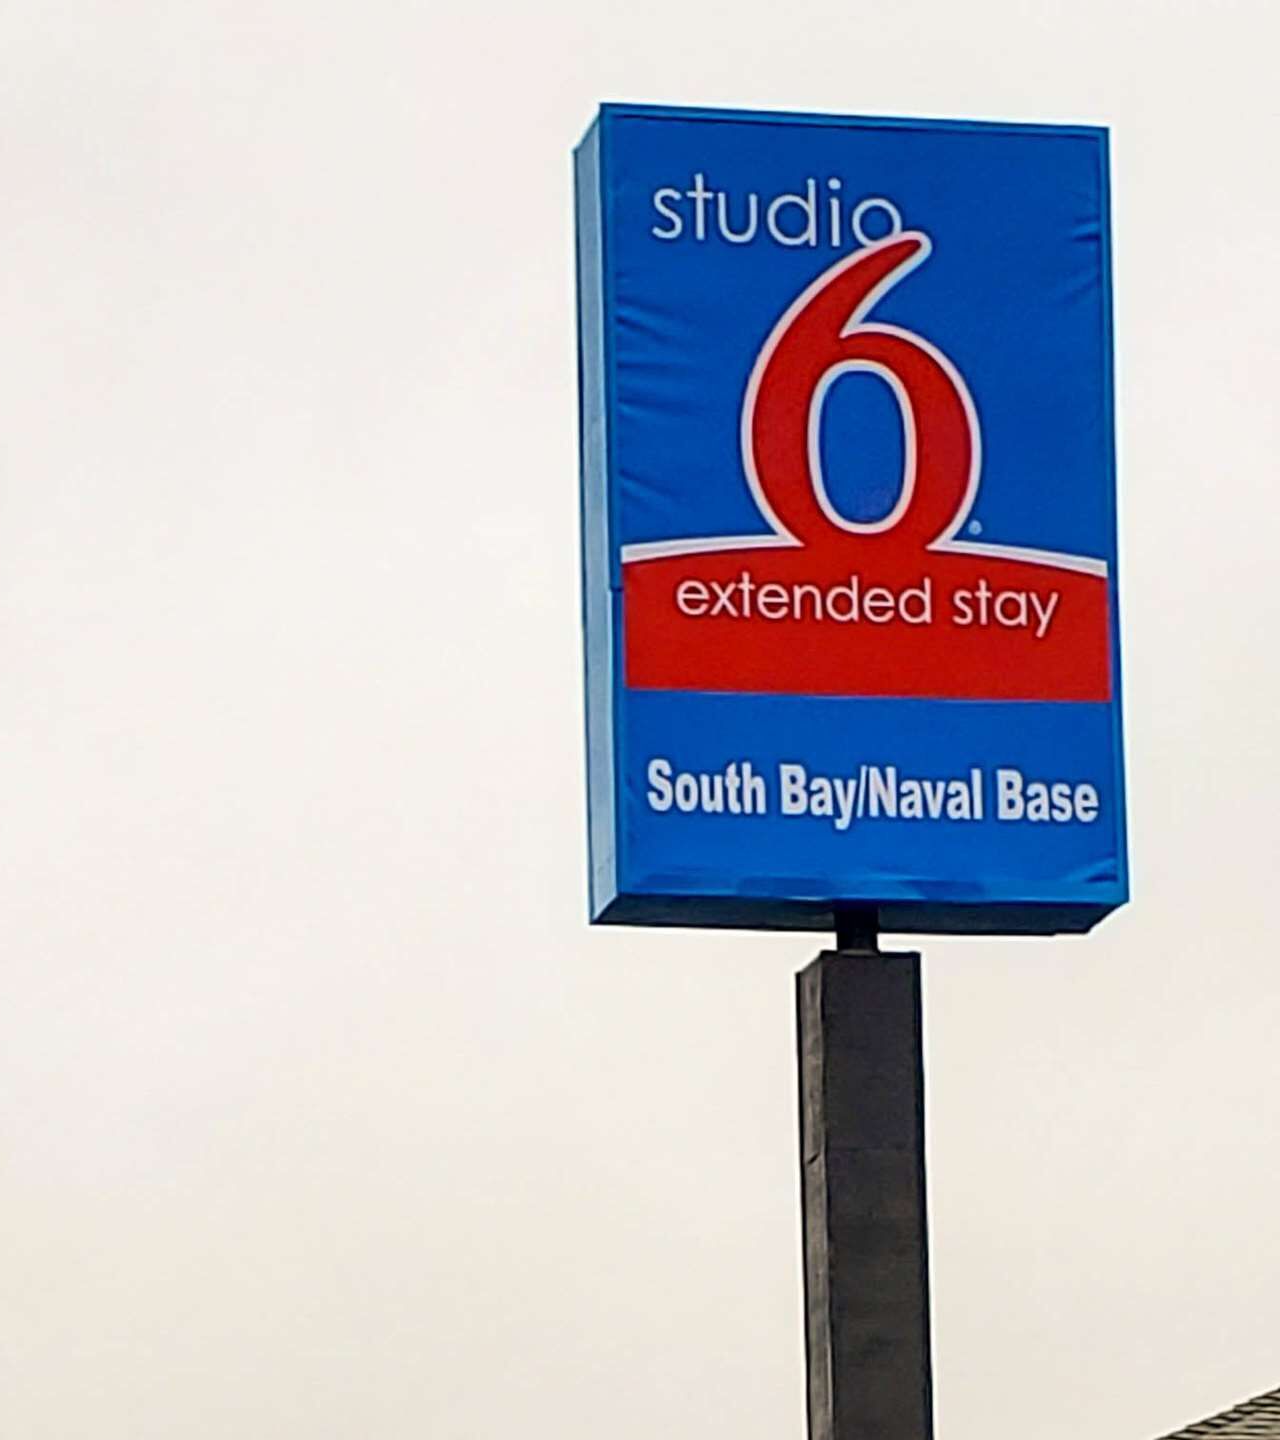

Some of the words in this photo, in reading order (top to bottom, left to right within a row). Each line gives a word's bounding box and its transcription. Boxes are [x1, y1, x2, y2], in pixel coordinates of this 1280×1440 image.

[651, 173, 903, 247] studio
[741, 230, 980, 546] 6
[676, 572, 932, 624] extended
[952, 579, 1058, 637] stay
[647, 758, 766, 815] South
[779, 763, 984, 830] Bay/Naval
[997, 769, 1099, 822] Base
